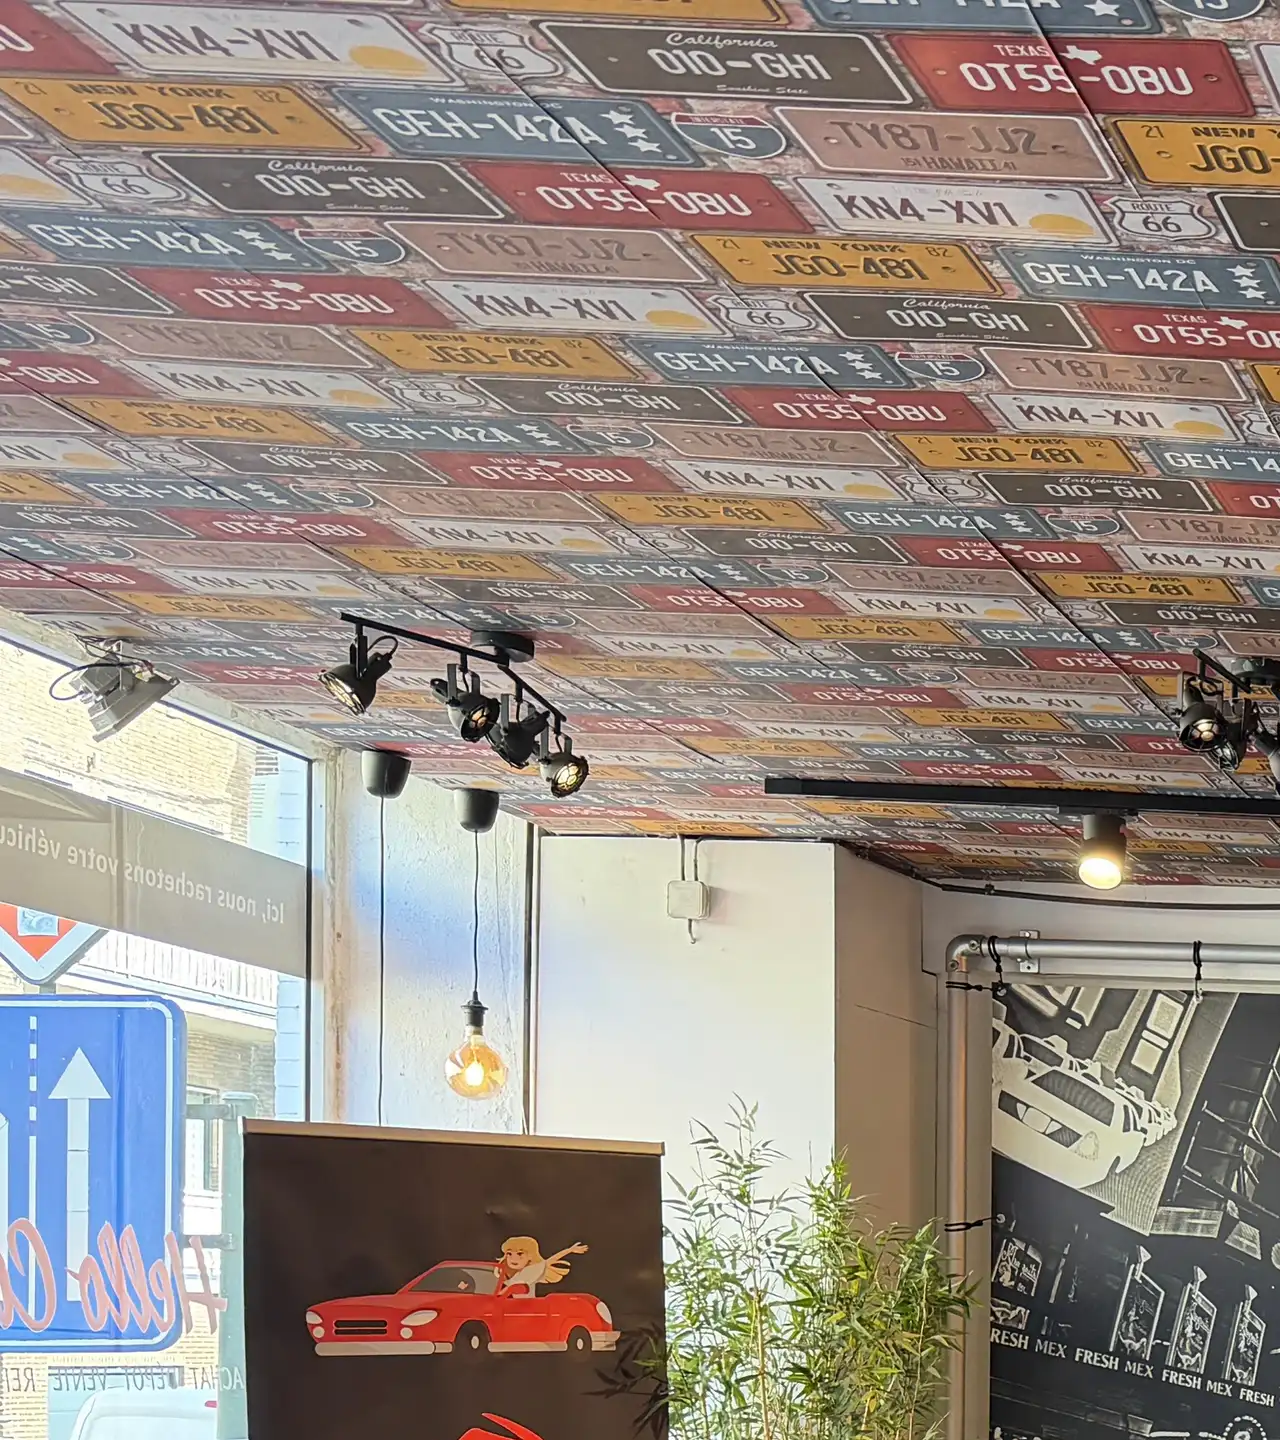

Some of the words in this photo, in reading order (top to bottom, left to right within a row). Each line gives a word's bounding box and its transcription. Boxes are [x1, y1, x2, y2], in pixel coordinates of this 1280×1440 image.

[660, 31, 782, 50] California
[992, 42, 1052, 57] TEXAS
[371, 107, 611, 147] GEH-142A
[1129, 203, 1177, 212] ROUTE
[1136, 214, 1183, 232] 66
[25, 224, 250, 257] GEH-142A
[1022, 262, 1221, 294] GEH-142A
[344, 421, 524, 445] GEH-142A
[1035, 1338, 1067, 1358] MEX
[1074, 1348, 1119, 1371] FRESH
[1125, 1360, 1153, 1378] MEX
[1162, 1369, 1202, 1389] FRESH
[1206, 1380, 1232, 1397] MEX
[1239, 1388, 1275, 1407] FRESH
